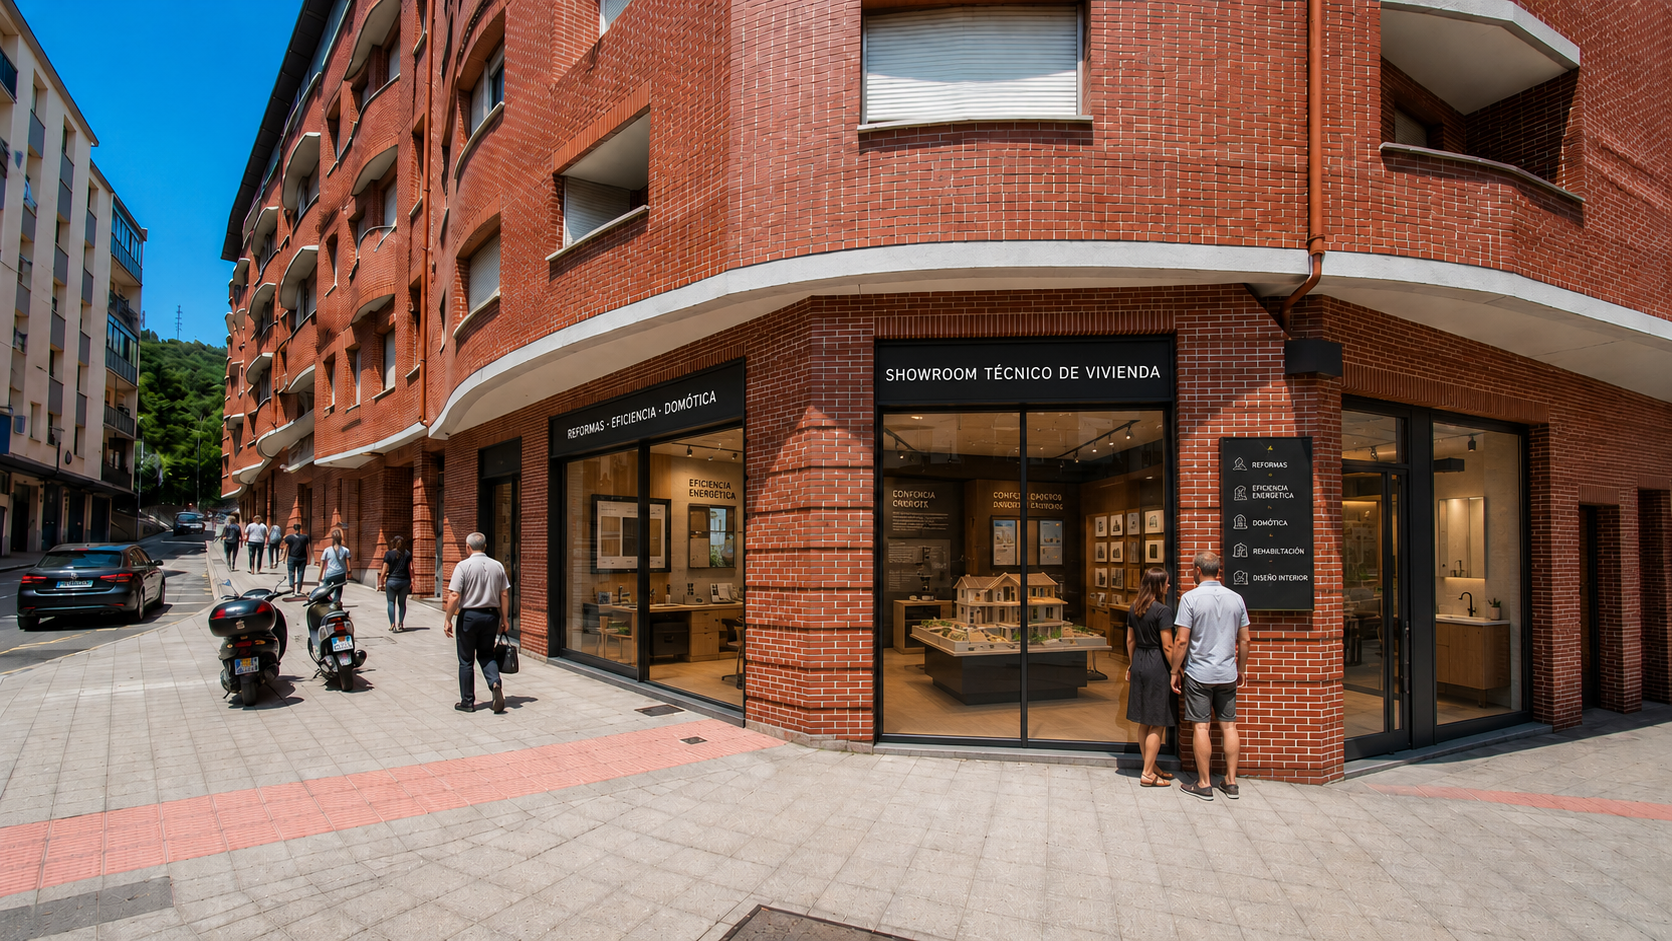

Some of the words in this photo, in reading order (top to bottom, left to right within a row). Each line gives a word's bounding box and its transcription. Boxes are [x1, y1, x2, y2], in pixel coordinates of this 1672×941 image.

[885, 367, 977, 382] SHOWROOM
[984, 363, 1052, 380] TÉCNICO
[1059, 366, 1079, 380] DE
[1085, 365, 1161, 379] VIVIENDA
[567, 420, 605, 440] REFORMAS
[611, 406, 657, 429] EFICIENCIA
[664, 390, 717, 415] DOMÓTICA
[1251, 461, 1288, 469] REFORMAS
[689, 478, 732, 490] EFICIENCIA
[1252, 573, 1277, 582] DISEÑO
[1278, 574, 1309, 582] INTERIOR
